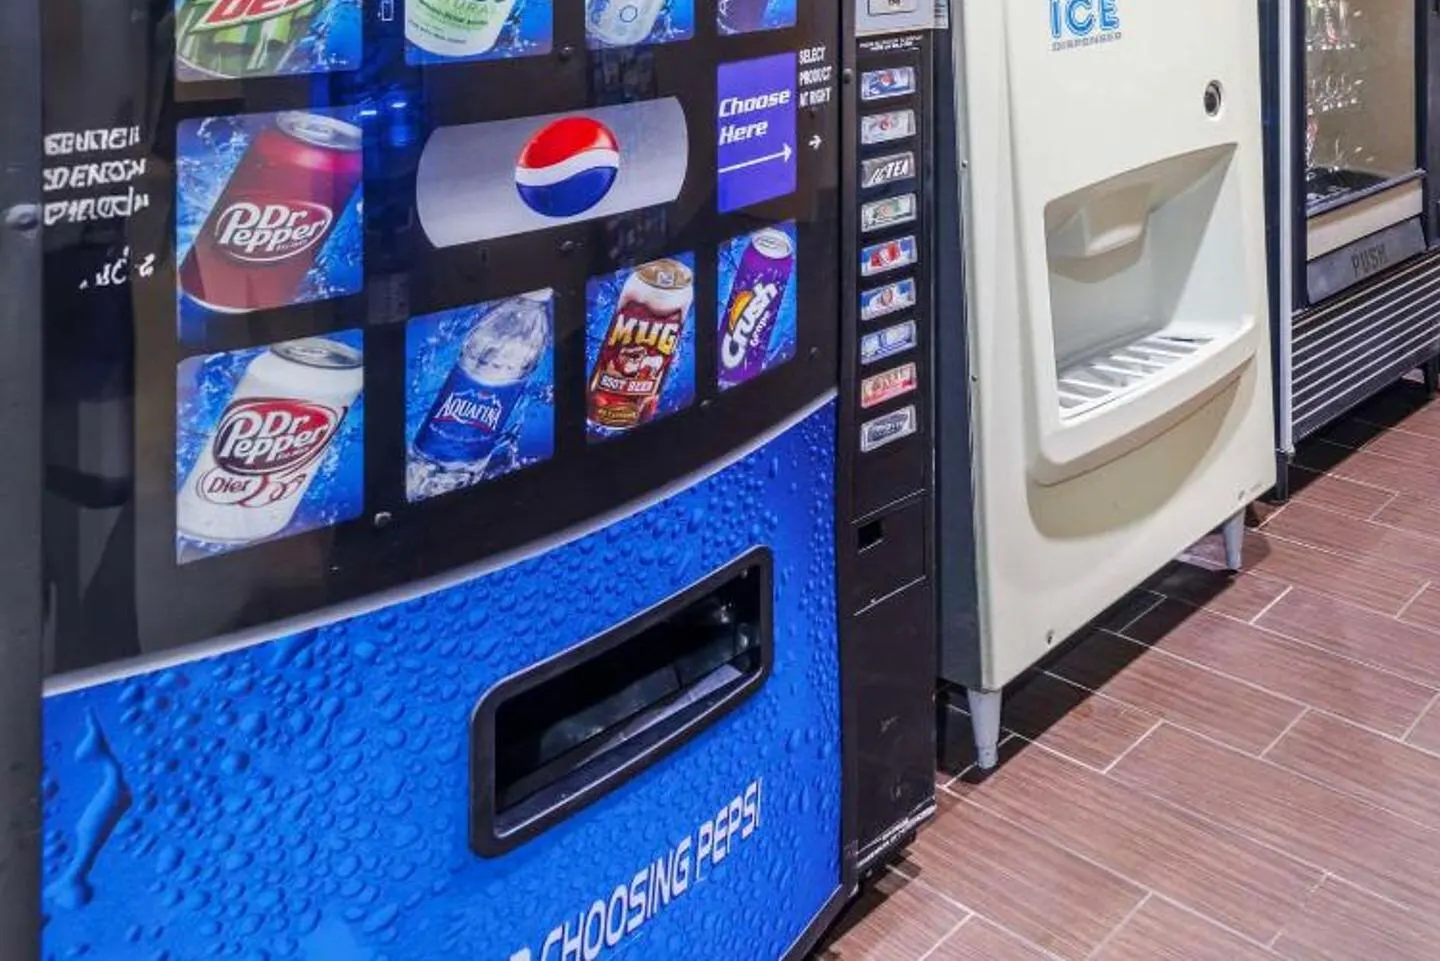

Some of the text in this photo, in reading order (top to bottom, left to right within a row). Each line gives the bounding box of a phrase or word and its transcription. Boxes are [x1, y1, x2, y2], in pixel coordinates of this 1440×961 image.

[798, 46, 826, 65] SELECT
[718, 89, 791, 118] Choose
[718, 121, 769, 146] Here
[219, 202, 326, 254] Pepper
[259, 204, 308, 229] Dr
[1351, 243, 1389, 278] PUSH
[607, 313, 679, 356] MUG
[721, 282, 778, 369] Crush
[259, 411, 310, 438] Dr
[434, 392, 503, 431] AQUAFINA
[218, 409, 330, 466] Pepper
[207, 476, 250, 494] Diet
[541, 776, 763, 961] CHOOSING PEPSI
